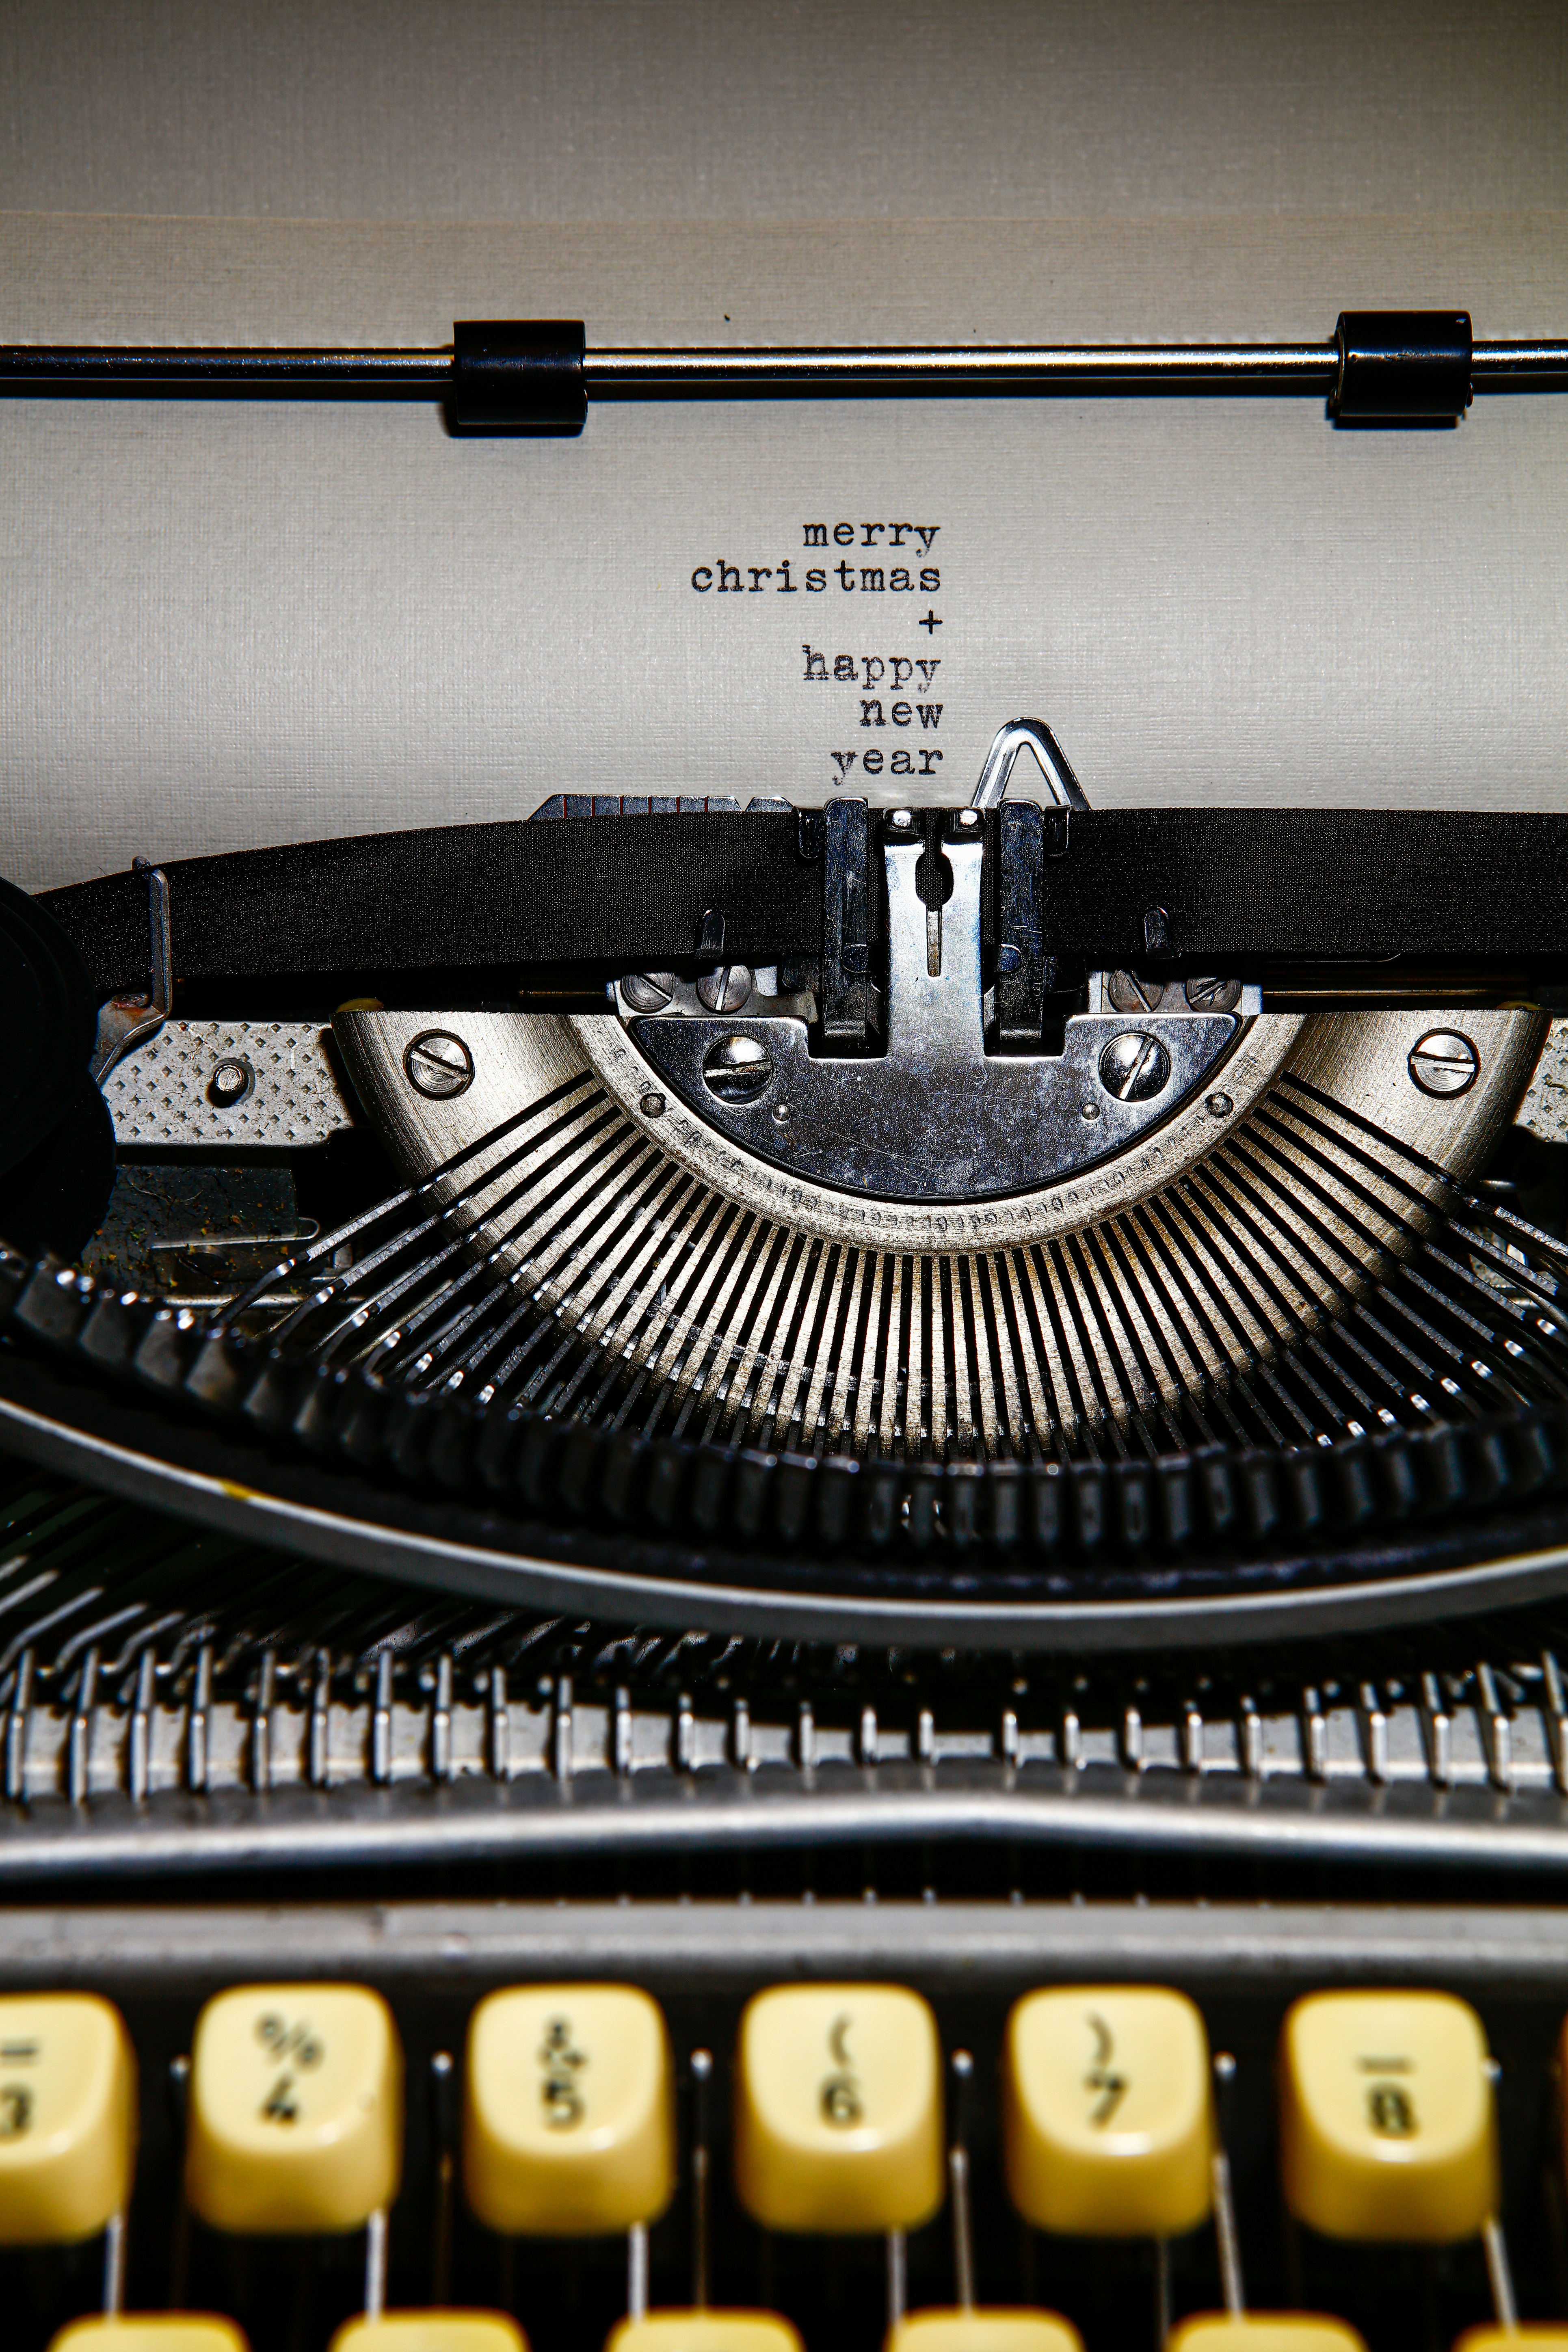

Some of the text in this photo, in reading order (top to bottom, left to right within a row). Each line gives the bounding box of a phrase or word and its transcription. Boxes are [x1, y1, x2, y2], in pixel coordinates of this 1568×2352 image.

[802, 522, 941, 558] merry
[691, 559, 941, 592] christmas
[919, 610, 943, 635] +
[802, 644, 941, 693] happy
[859, 699, 943, 729] new
[830, 749, 943, 786] year
[258, 2073, 301, 2128] 4
[540, 2076, 586, 2132] 5
[818, 2071, 864, 2129] 6
[1084, 2070, 1129, 2129] 7
